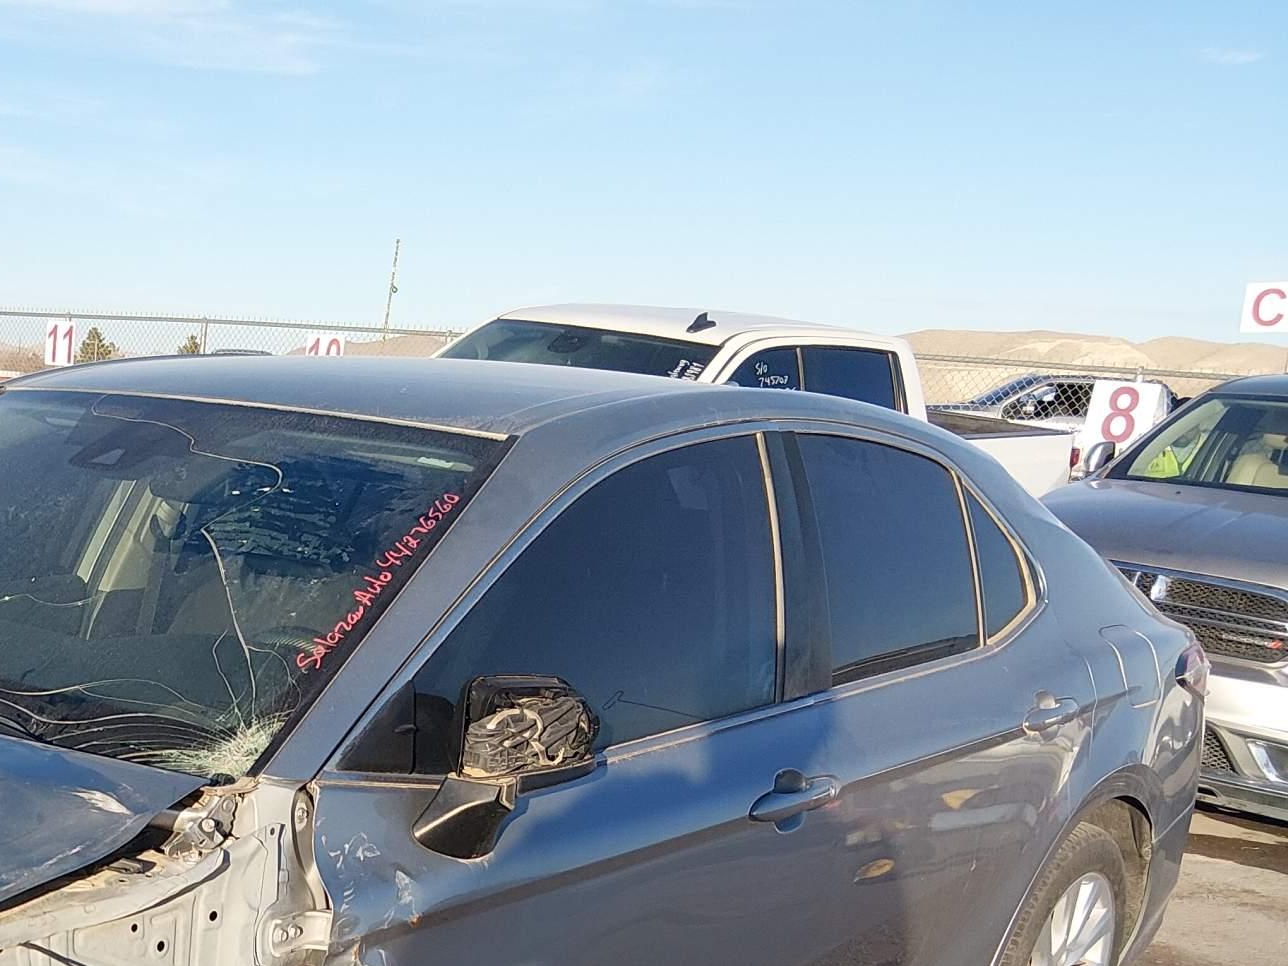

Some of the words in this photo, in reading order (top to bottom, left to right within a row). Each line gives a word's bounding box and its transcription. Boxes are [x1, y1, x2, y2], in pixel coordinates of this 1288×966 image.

[1252, 288, 1287, 327] C
[47, 324, 74, 364] 11
[1100, 386, 1140, 444] 8
[353, 571, 393, 606] Auto
[376, 492, 461, 566] 44276560
